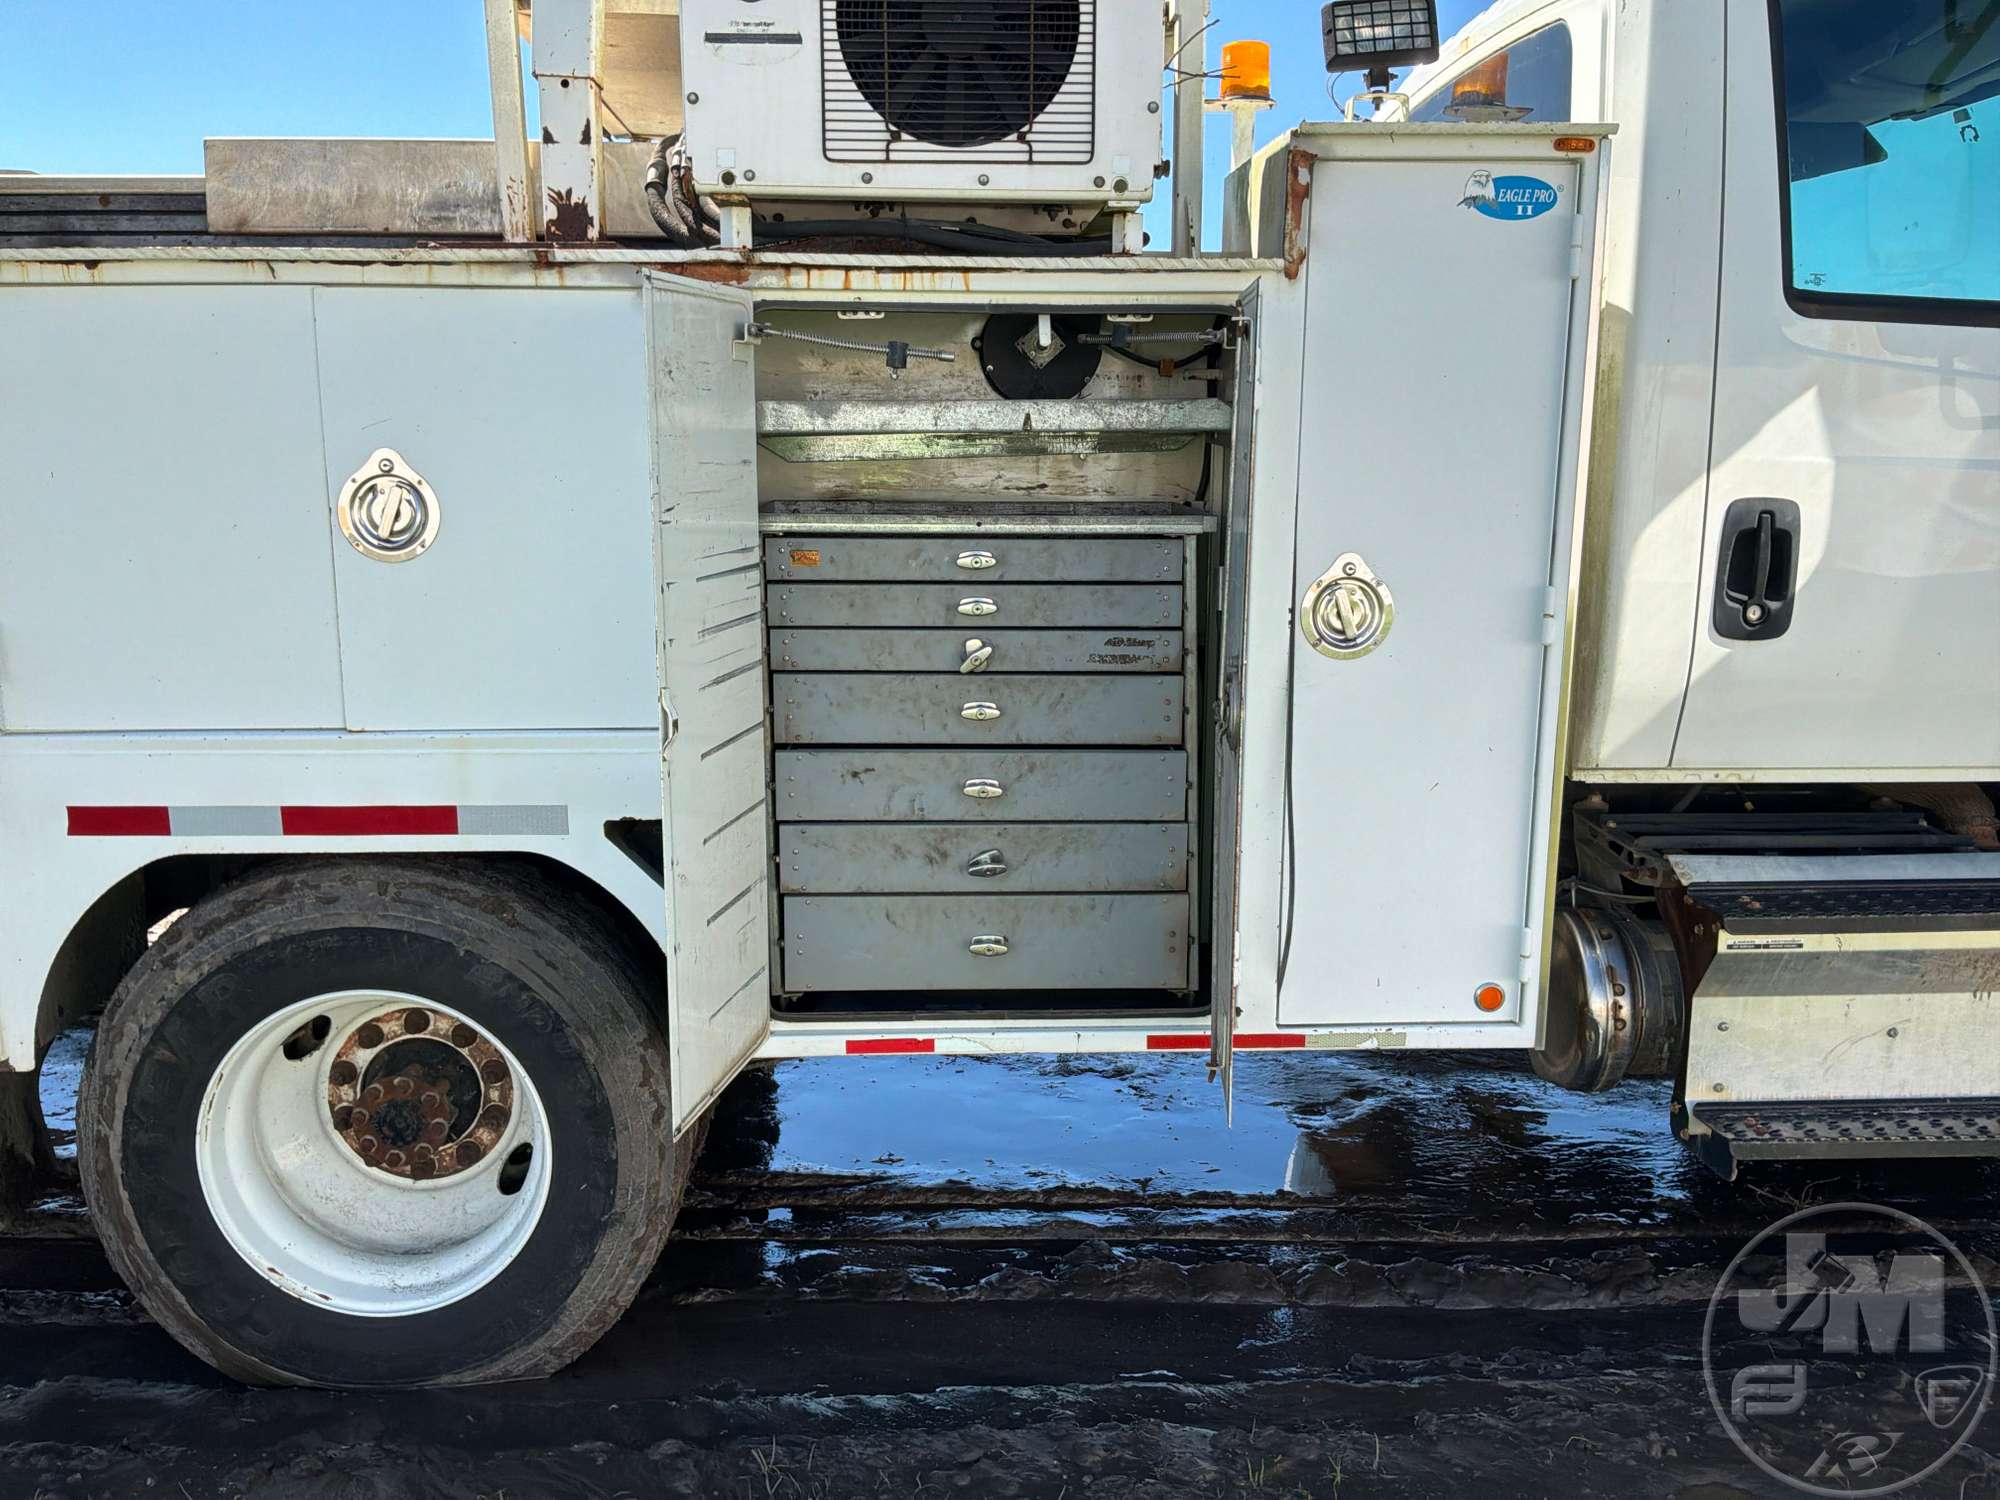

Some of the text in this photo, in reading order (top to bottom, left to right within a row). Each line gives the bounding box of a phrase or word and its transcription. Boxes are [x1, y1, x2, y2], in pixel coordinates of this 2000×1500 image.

[1498, 188, 1554, 203] EAGLE PRO
[1516, 205, 1534, 216] II
